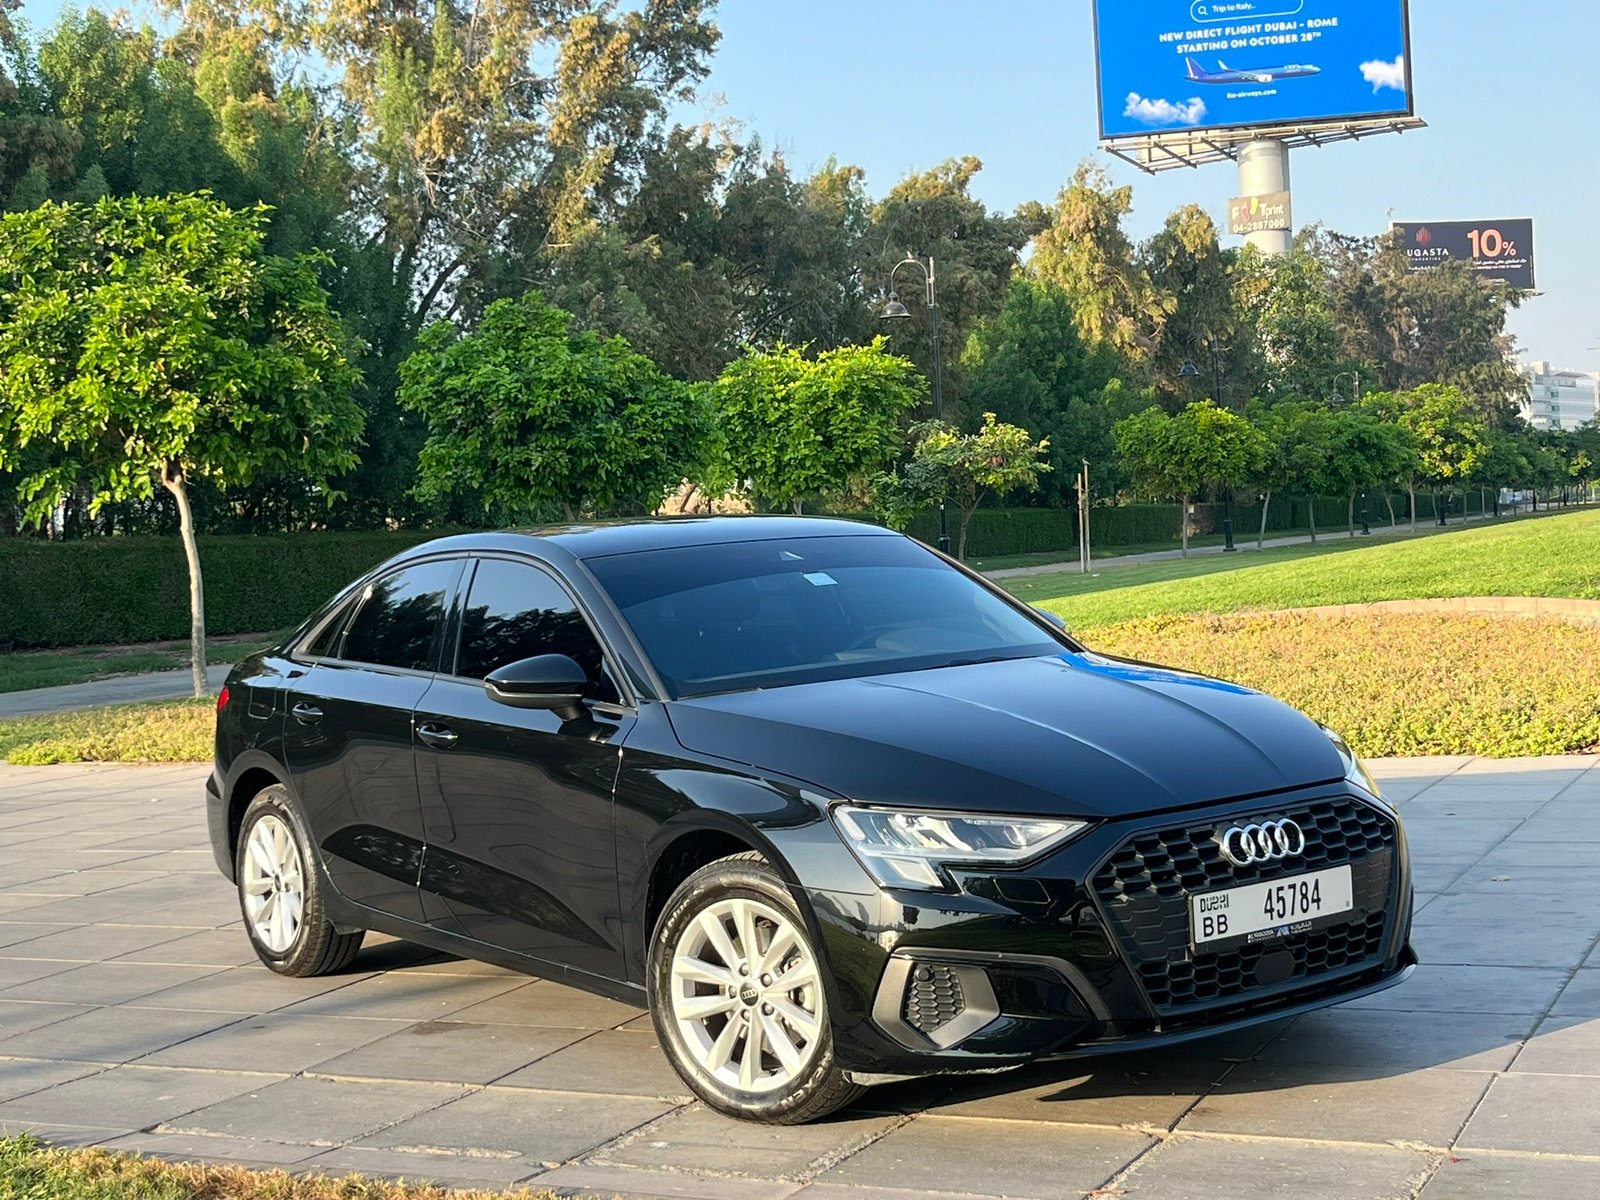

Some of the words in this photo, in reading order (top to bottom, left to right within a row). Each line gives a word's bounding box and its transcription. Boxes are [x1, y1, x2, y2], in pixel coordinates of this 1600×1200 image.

[1212, 5, 1226, 13] Trip
[1159, 32, 1183, 42] NEW
[1186, 28, 1222, 40] DIRECT
[1225, 24, 1262, 37] FLIGHT
[1264, 21, 1297, 33] DUBAI
[1307, 17, 1338, 29] ROME
[1176, 40, 1229, 54] STARTING
[1230, 37, 1248, 49] ON
[1249, 33, 1298, 47] OCTOBER
[1406, 248, 1449, 257] UGASTA
[1467, 229, 1517, 258] 10%
[1264, 878, 1321, 921] 45784
[1203, 914, 1228, 938] BB
